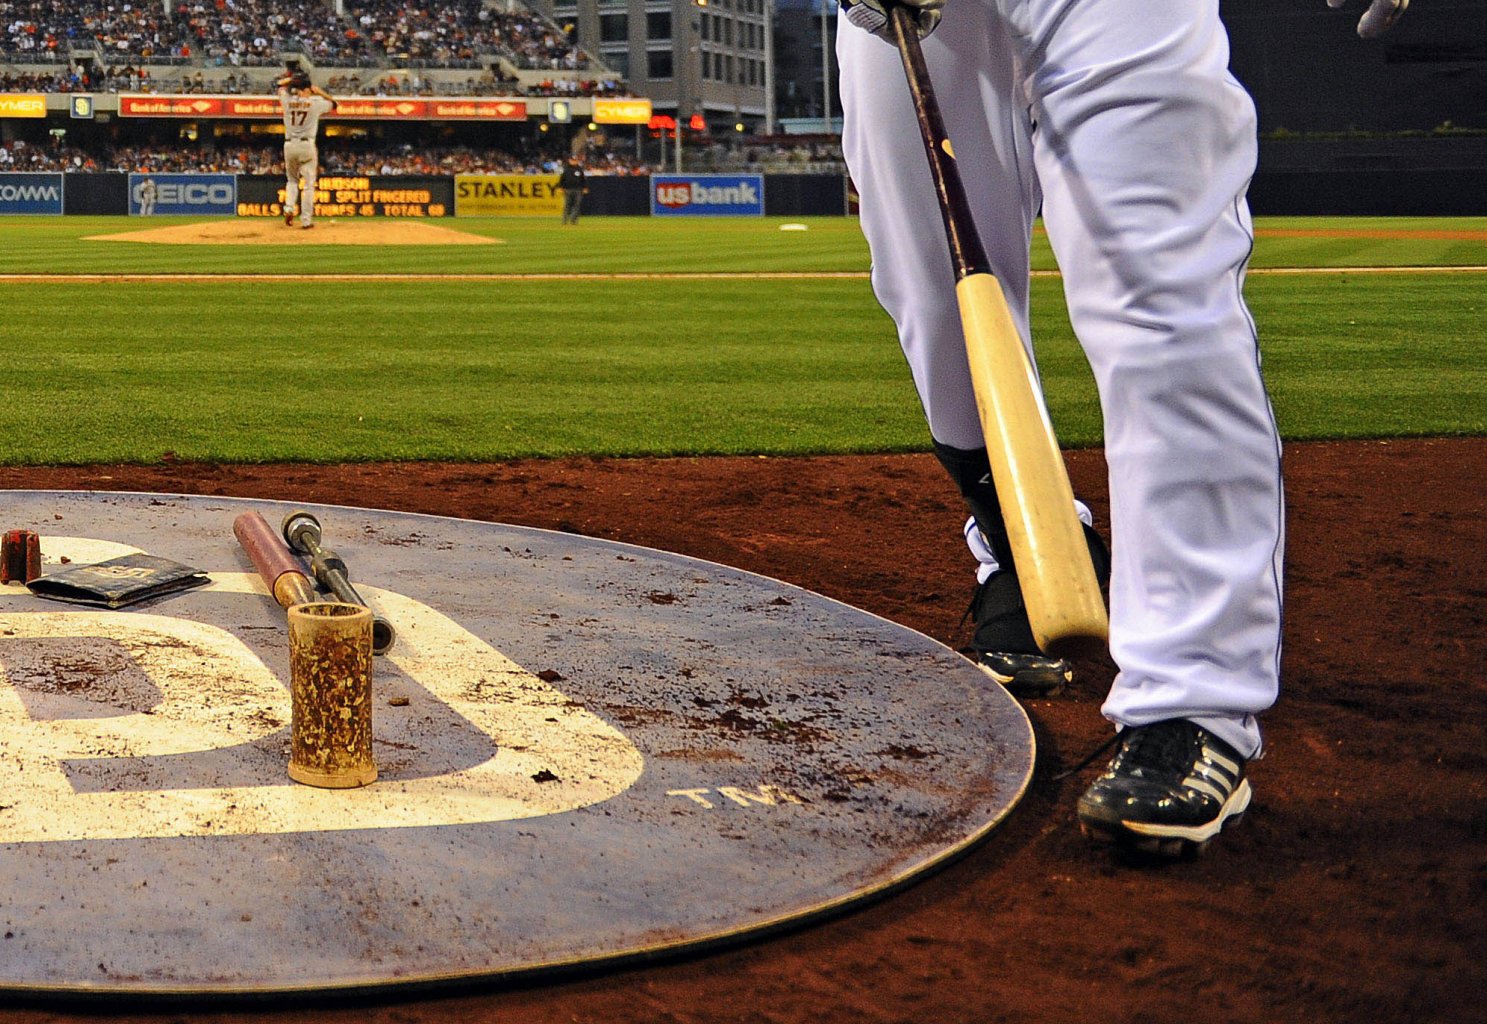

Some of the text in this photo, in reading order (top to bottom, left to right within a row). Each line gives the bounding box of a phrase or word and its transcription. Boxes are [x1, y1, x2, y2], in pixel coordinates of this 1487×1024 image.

[291, 110, 308, 126] 17
[458, 181, 561, 199] STANLEY
[657, 182, 758, 205] us bank
[384, 204, 424, 217] TOTAL
